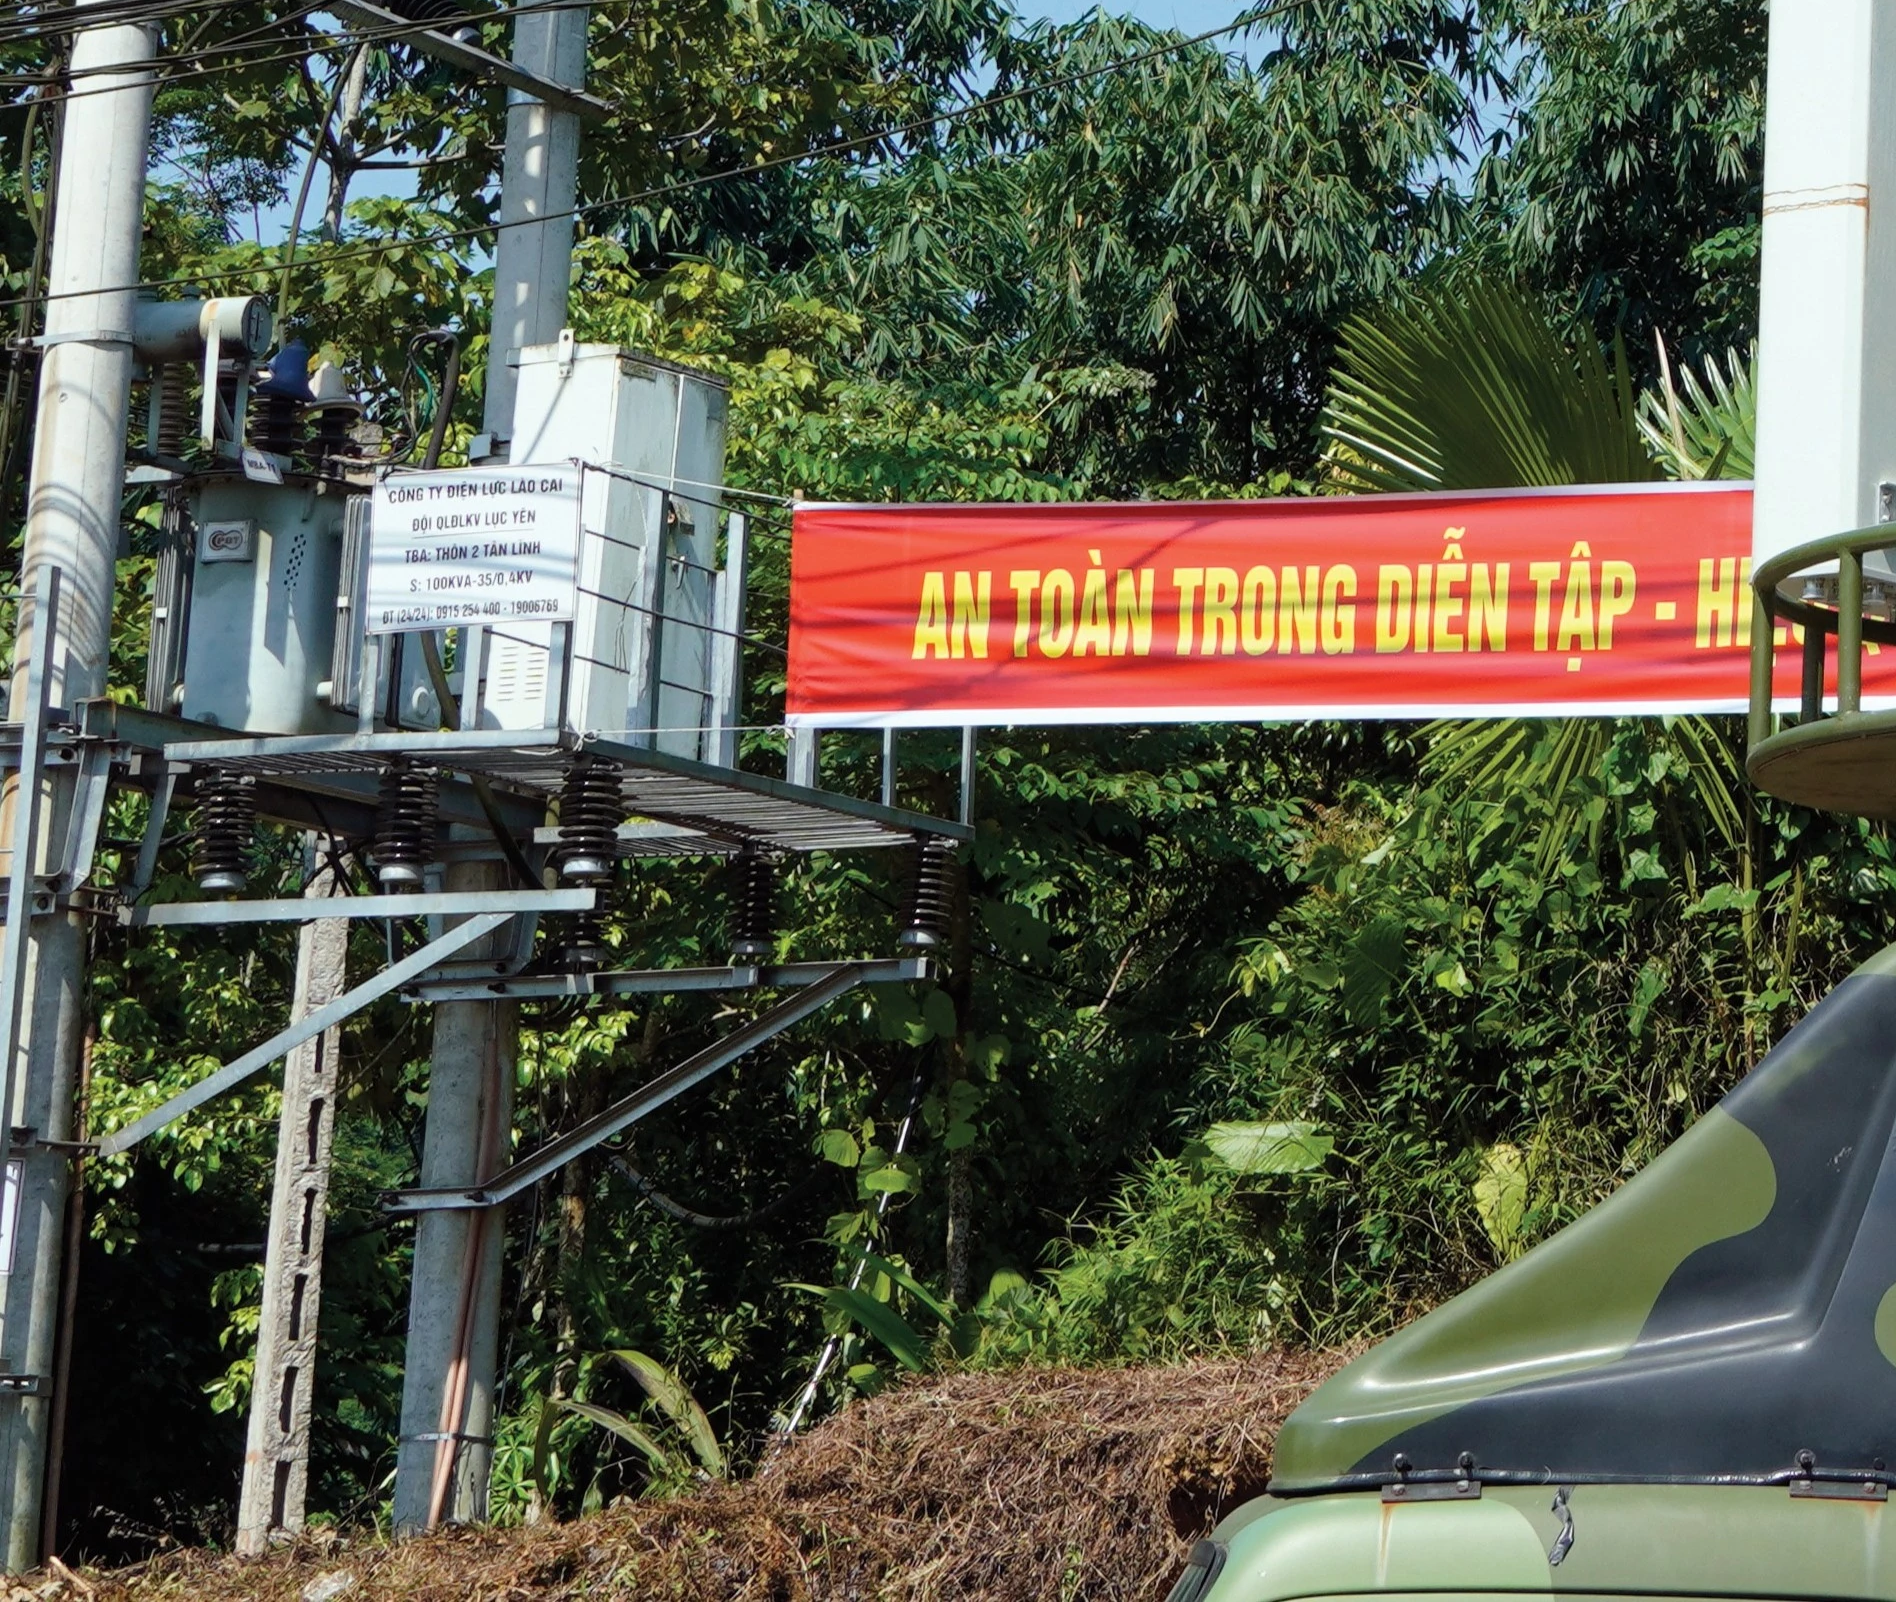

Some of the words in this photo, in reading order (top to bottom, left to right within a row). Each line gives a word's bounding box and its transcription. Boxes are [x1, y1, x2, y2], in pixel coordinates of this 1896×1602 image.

[388, 486, 424, 504] CÔNG
[428, 486, 443, 500] TY
[447, 480, 478, 501] ĐIỆN
[482, 480, 507, 499] LỰC
[511, 477, 536, 494] LÀO
[540, 478, 563, 493] CAI
[412, 514, 432, 534] ĐỘI
[436, 512, 481, 531] QLĐLKV
[485, 511, 508, 529] LỤC
[512, 507, 536, 524] YÊN
[405, 549, 431, 564] TBA:
[436, 543, 468, 562] THÔN
[471, 545, 480, 559] 2
[483, 540, 508, 558] TÂN
[410, 578, 422, 593] S:
[911, 570, 993, 661] AN
[1009, 548, 1156, 660] TOÀN
[1172, 562, 1359, 658] TRONG
[1374, 525, 1511, 655] DIỄN
[1528, 539, 1639, 673] TẬP
[1655, 601, 1677, 621] -
[382, 611, 394, 625] ĐT
[436, 604, 459, 620] 0915
[462, 603, 480, 617] 254
[482, 601, 500, 616] 400
[510, 598, 559, 615] 19006769
